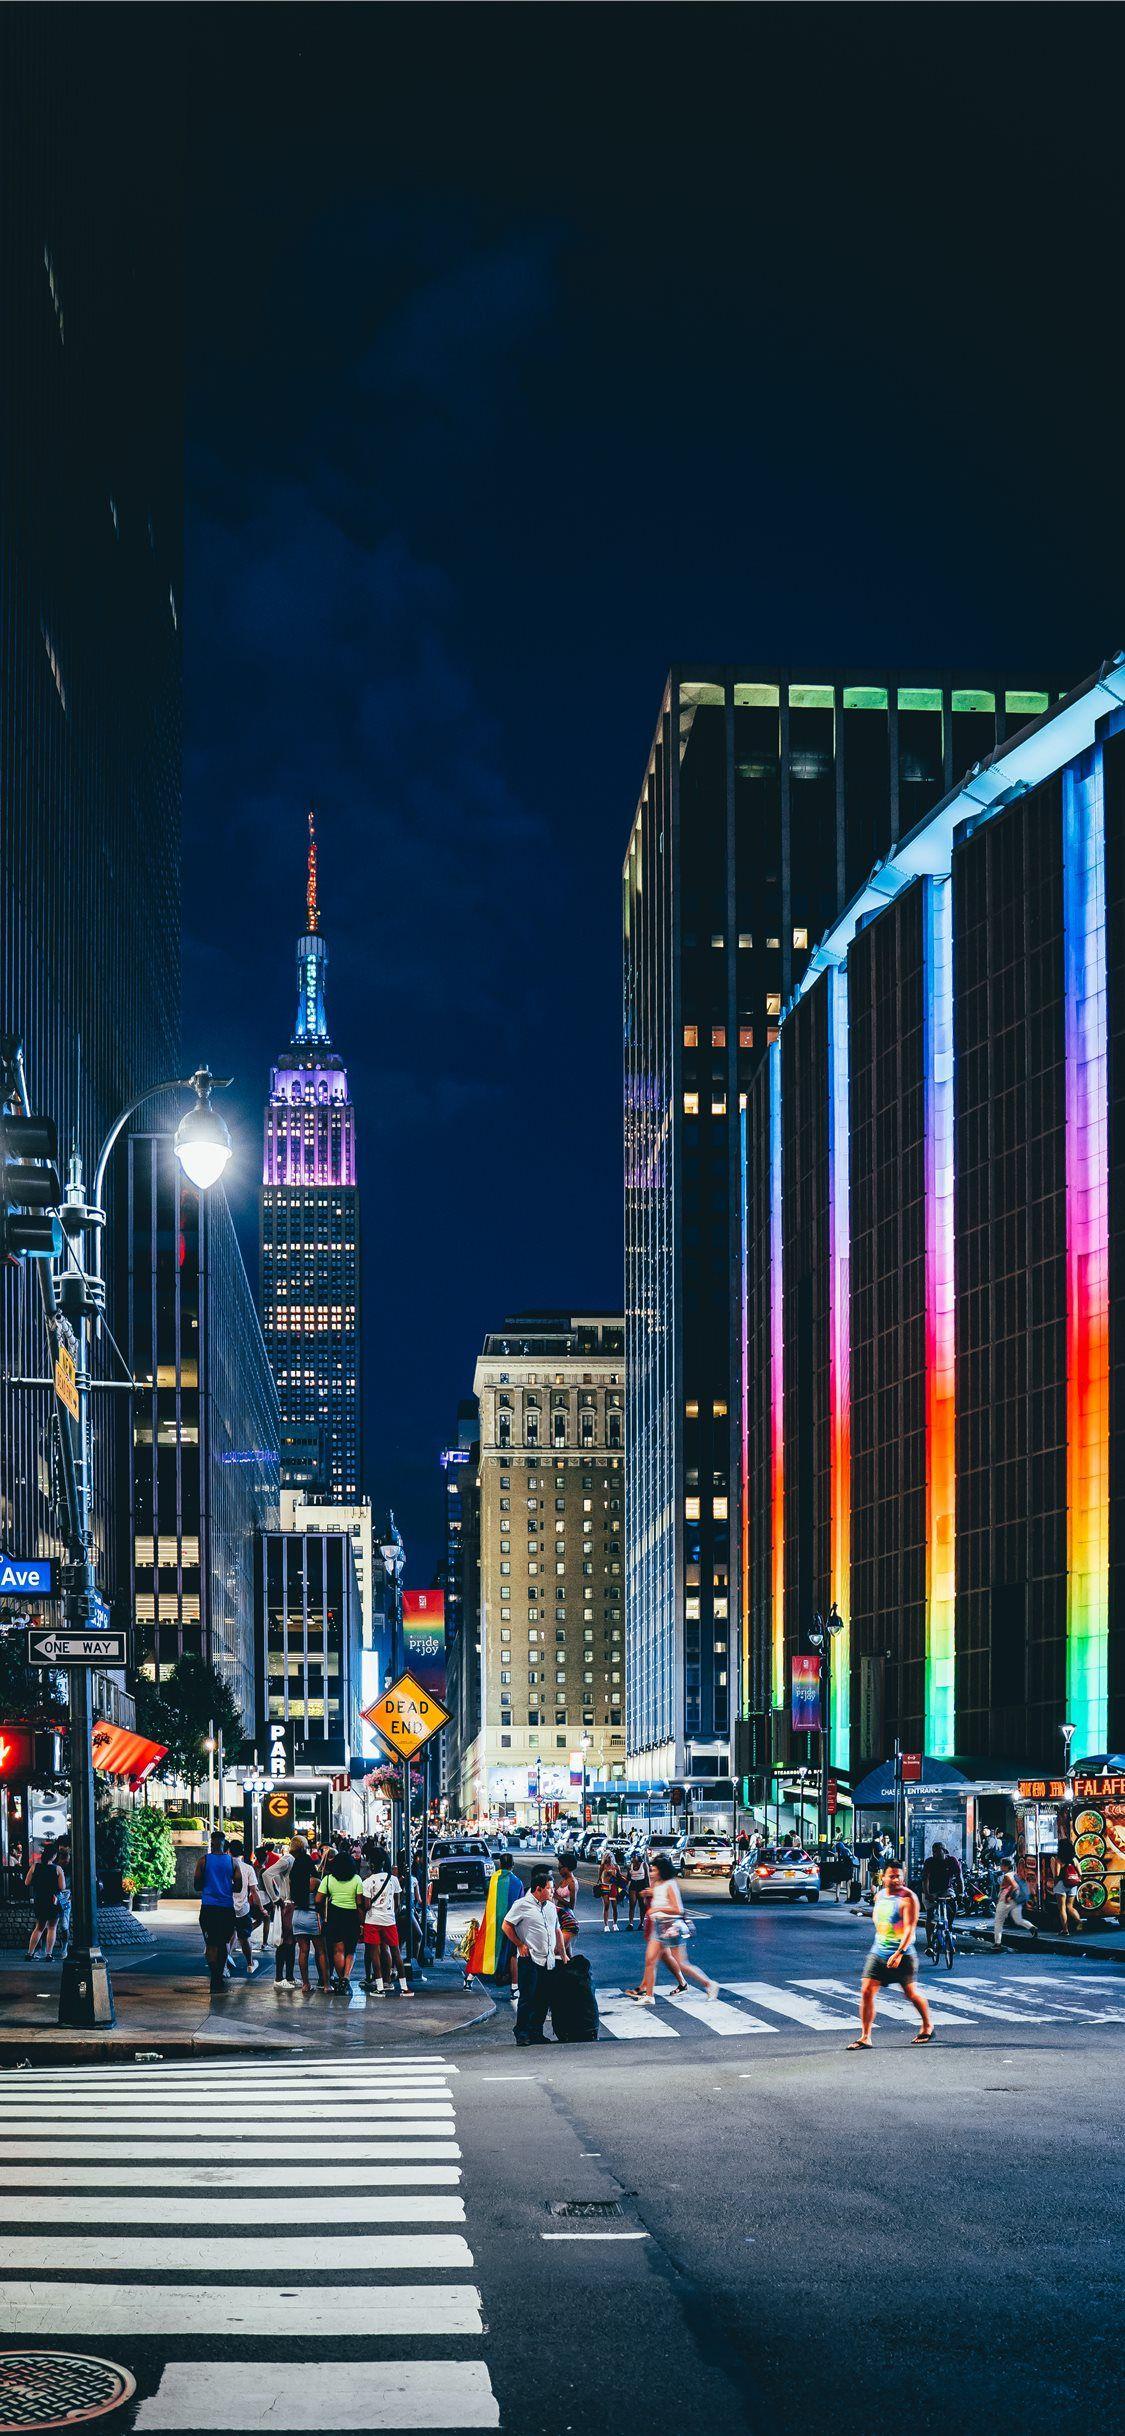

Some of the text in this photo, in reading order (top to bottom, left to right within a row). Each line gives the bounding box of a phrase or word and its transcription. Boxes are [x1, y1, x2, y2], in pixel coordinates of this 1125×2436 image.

[0, 1567, 40, 1586] Ave
[44, 1641, 111, 1653] ONE WAY
[409, 1636, 439, 1649] pride
[796, 1687, 816, 1697] pride
[385, 1700, 429, 1714] DEAD
[391, 1720, 423, 1734] END
[270, 1725, 287, 1778] PAR
[907, 1787, 943, 1795] ENTRANCE
